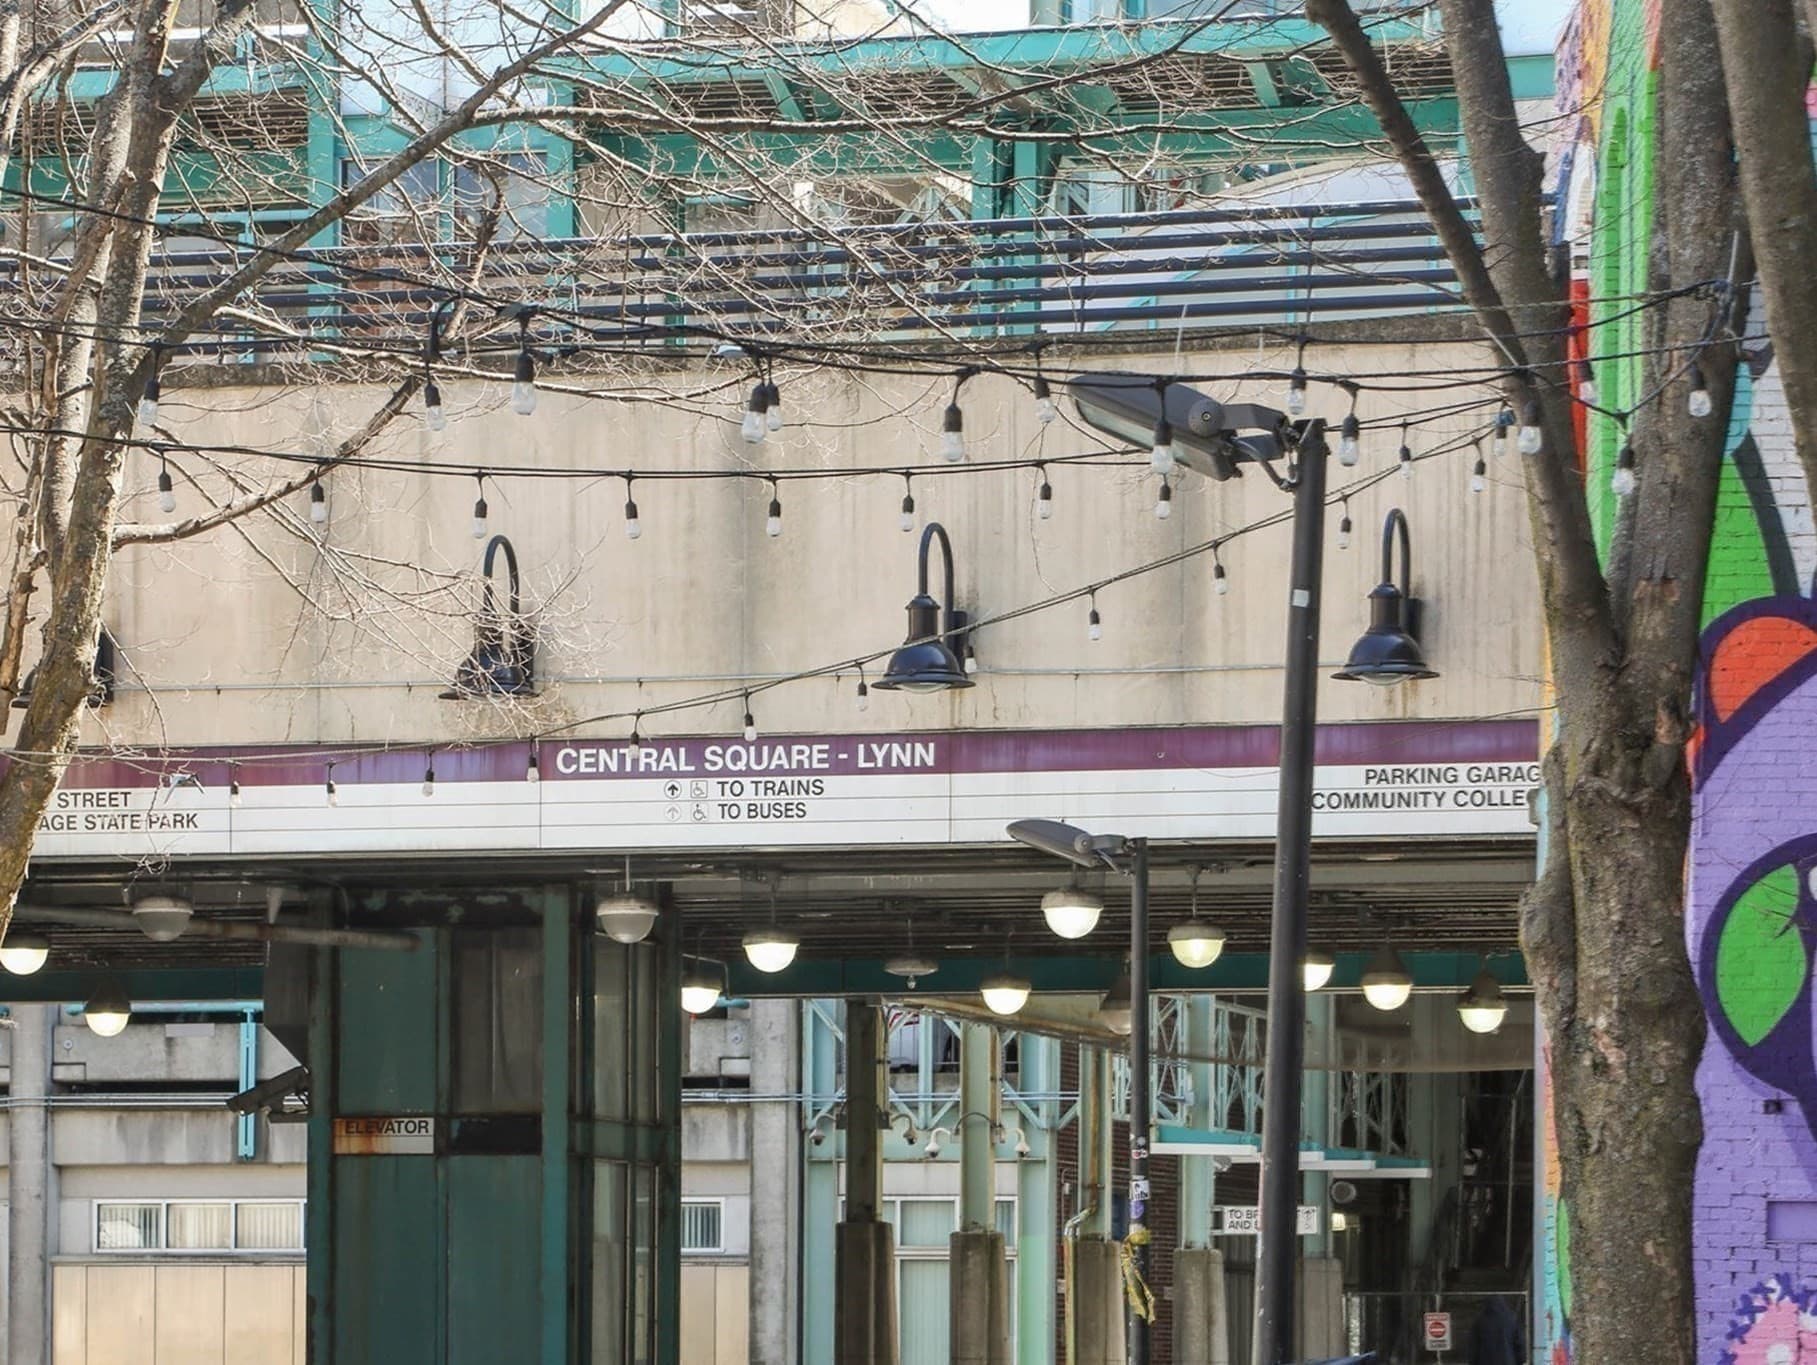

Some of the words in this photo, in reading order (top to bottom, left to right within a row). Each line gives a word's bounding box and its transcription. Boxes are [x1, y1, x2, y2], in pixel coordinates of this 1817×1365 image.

[556, 747, 696, 774] CENTRAL
[704, 744, 830, 773] SQUARE
[857, 742, 935, 769] LYNN
[1365, 766, 1459, 785] PARKING
[1466, 765, 1541, 783] GARAG
[717, 781, 744, 798] TO
[750, 779, 824, 797] TRAINS
[57, 791, 131, 808] STREET
[1311, 791, 1446, 809] COMMUNITY
[1453, 790, 1526, 808] COLLE
[717, 803, 741, 819] TO
[747, 802, 807, 819] BUSES
[38, 814, 77, 831] AGE
[84, 814, 141, 831] STATE
[149, 813, 199, 829] PARK
[345, 1120, 429, 1134] ELEVATOR
[1228, 1209, 1243, 1220] TO
[1228, 1220, 1251, 1230] AND
